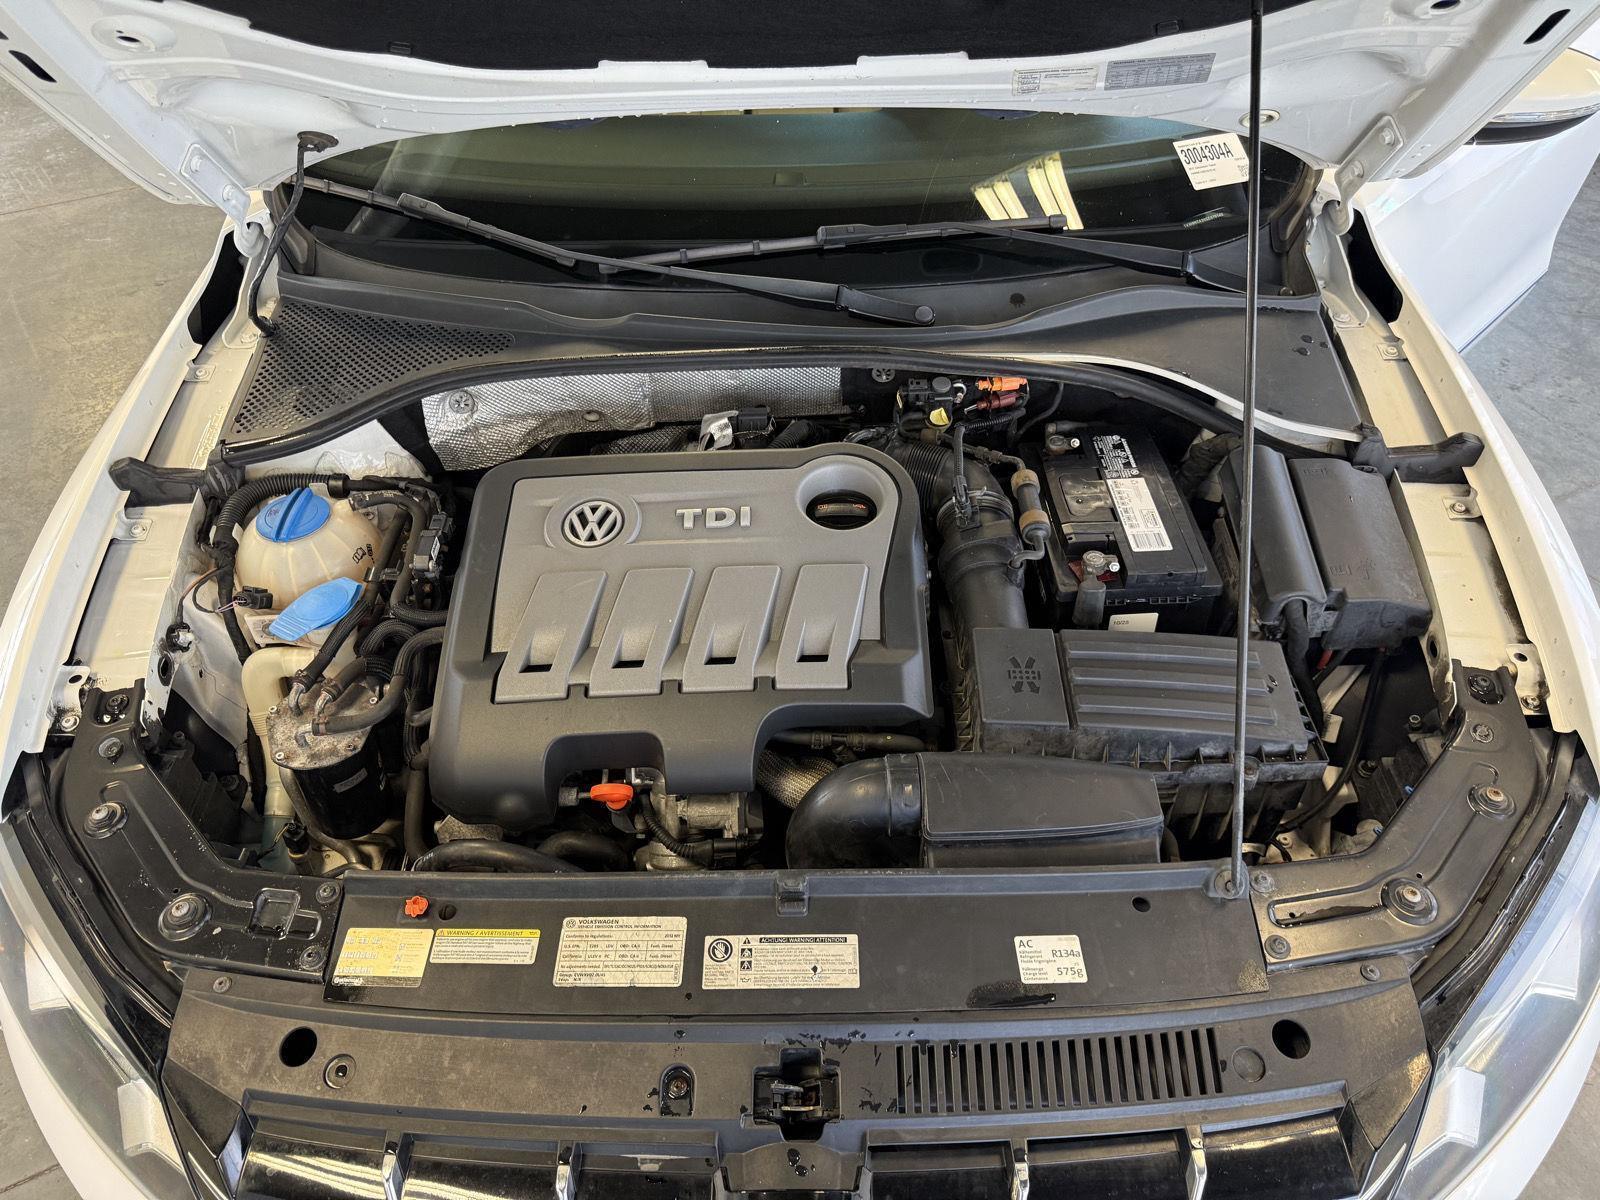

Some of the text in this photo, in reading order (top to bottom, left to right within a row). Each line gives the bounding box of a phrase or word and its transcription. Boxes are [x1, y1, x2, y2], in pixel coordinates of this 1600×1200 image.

[1181, 142, 1234, 165] 3004304A
[675, 506, 751, 530] TDI
[1018, 939, 1034, 948] AC
[1051, 949, 1081, 958] R134a
[1056, 967, 1084, 978] 575g
